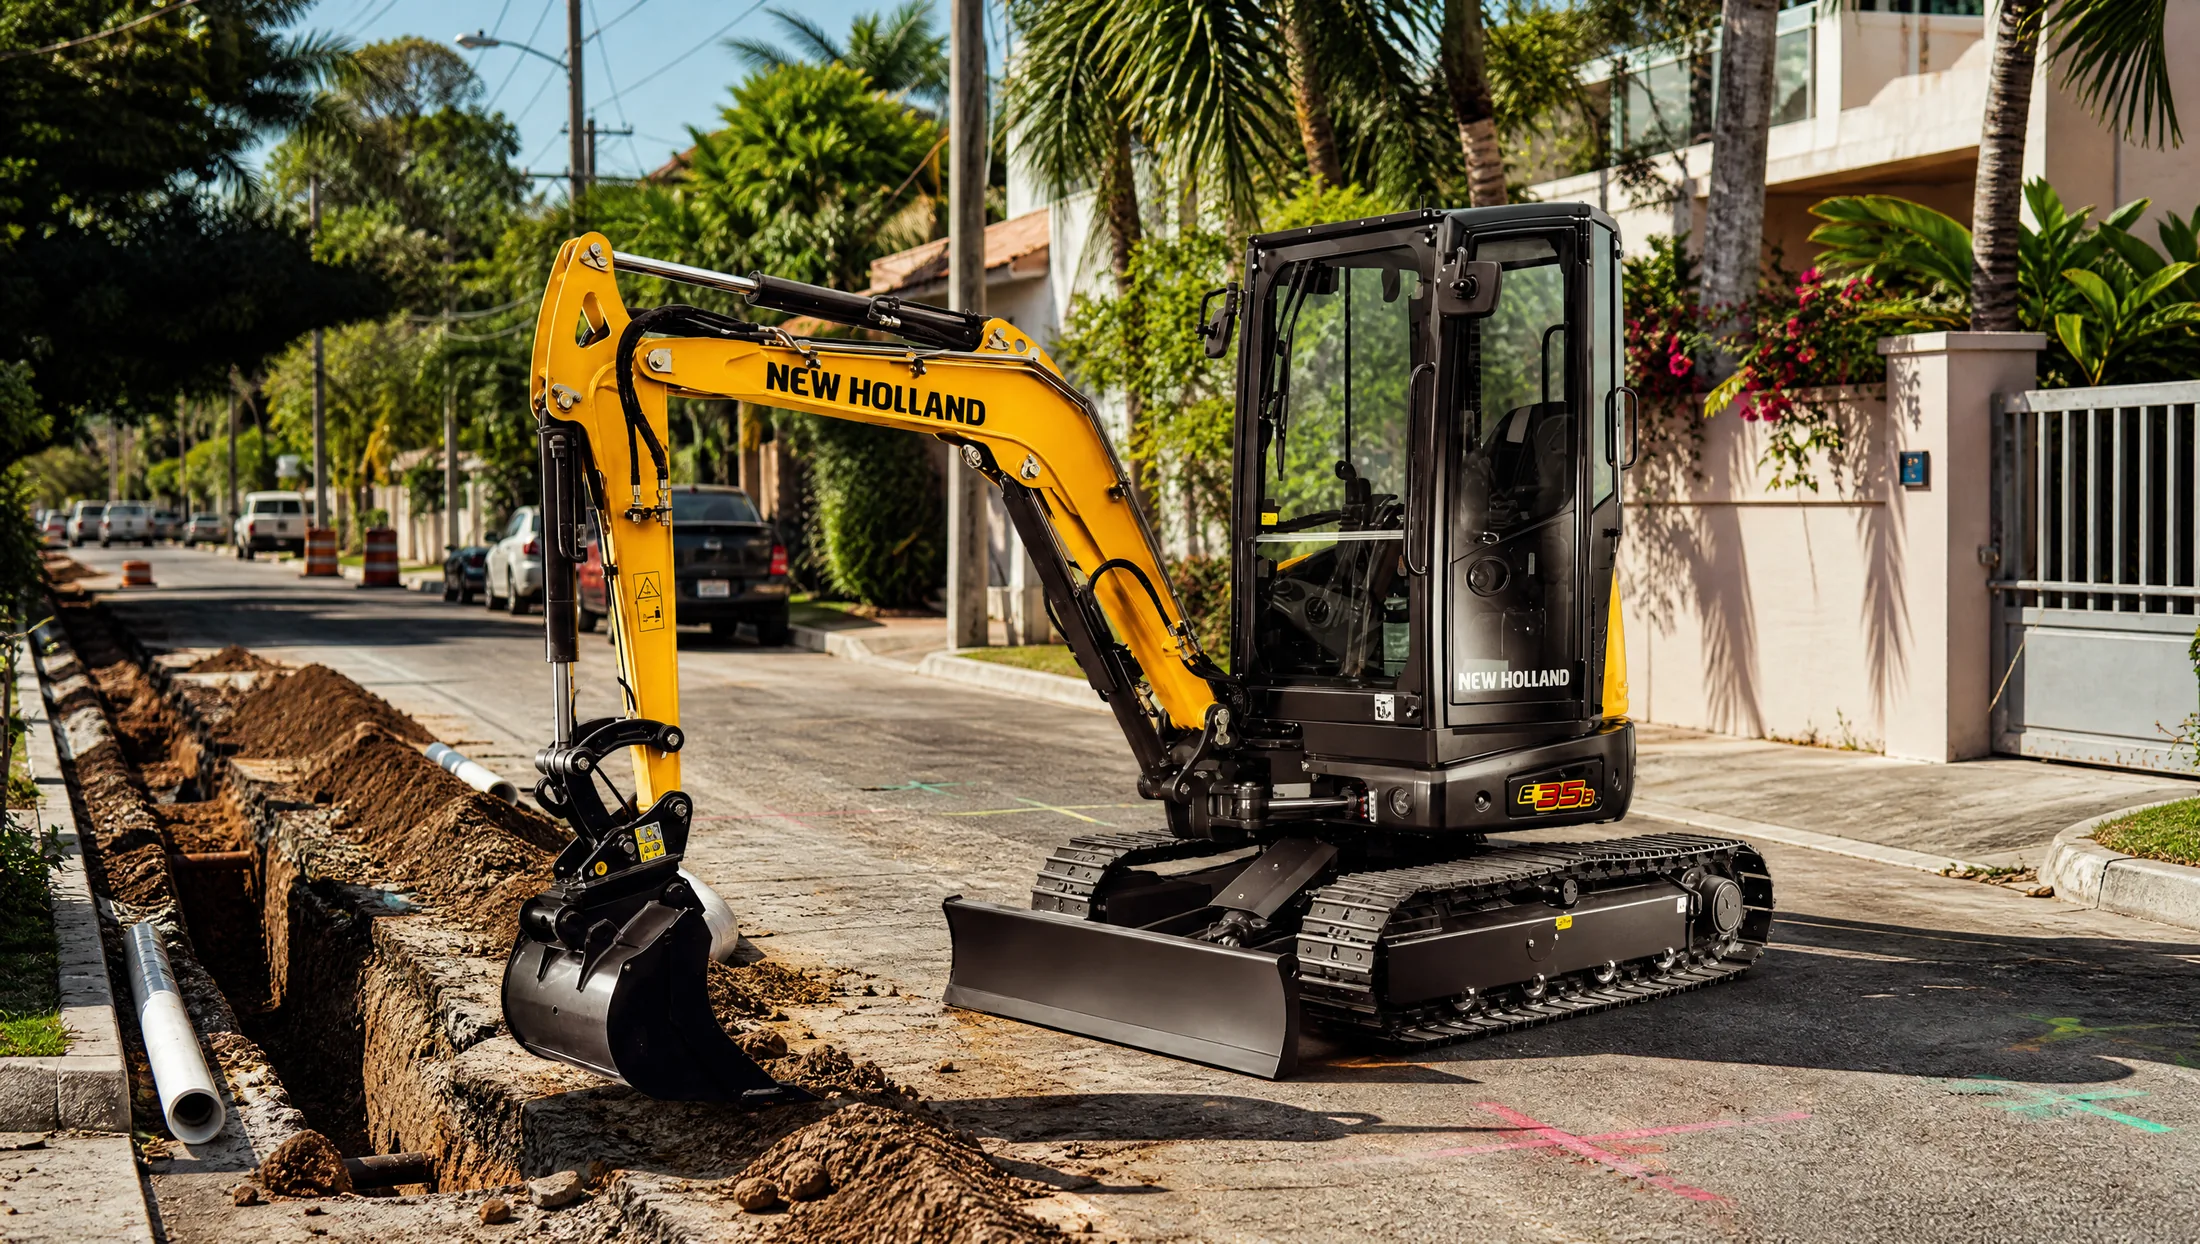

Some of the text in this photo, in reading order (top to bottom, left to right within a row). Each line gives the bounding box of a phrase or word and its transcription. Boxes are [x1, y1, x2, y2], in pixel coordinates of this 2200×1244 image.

[766, 361, 986, 427] NEW HOLLAND
[1458, 668, 1570, 691] NEW HOLLAND
